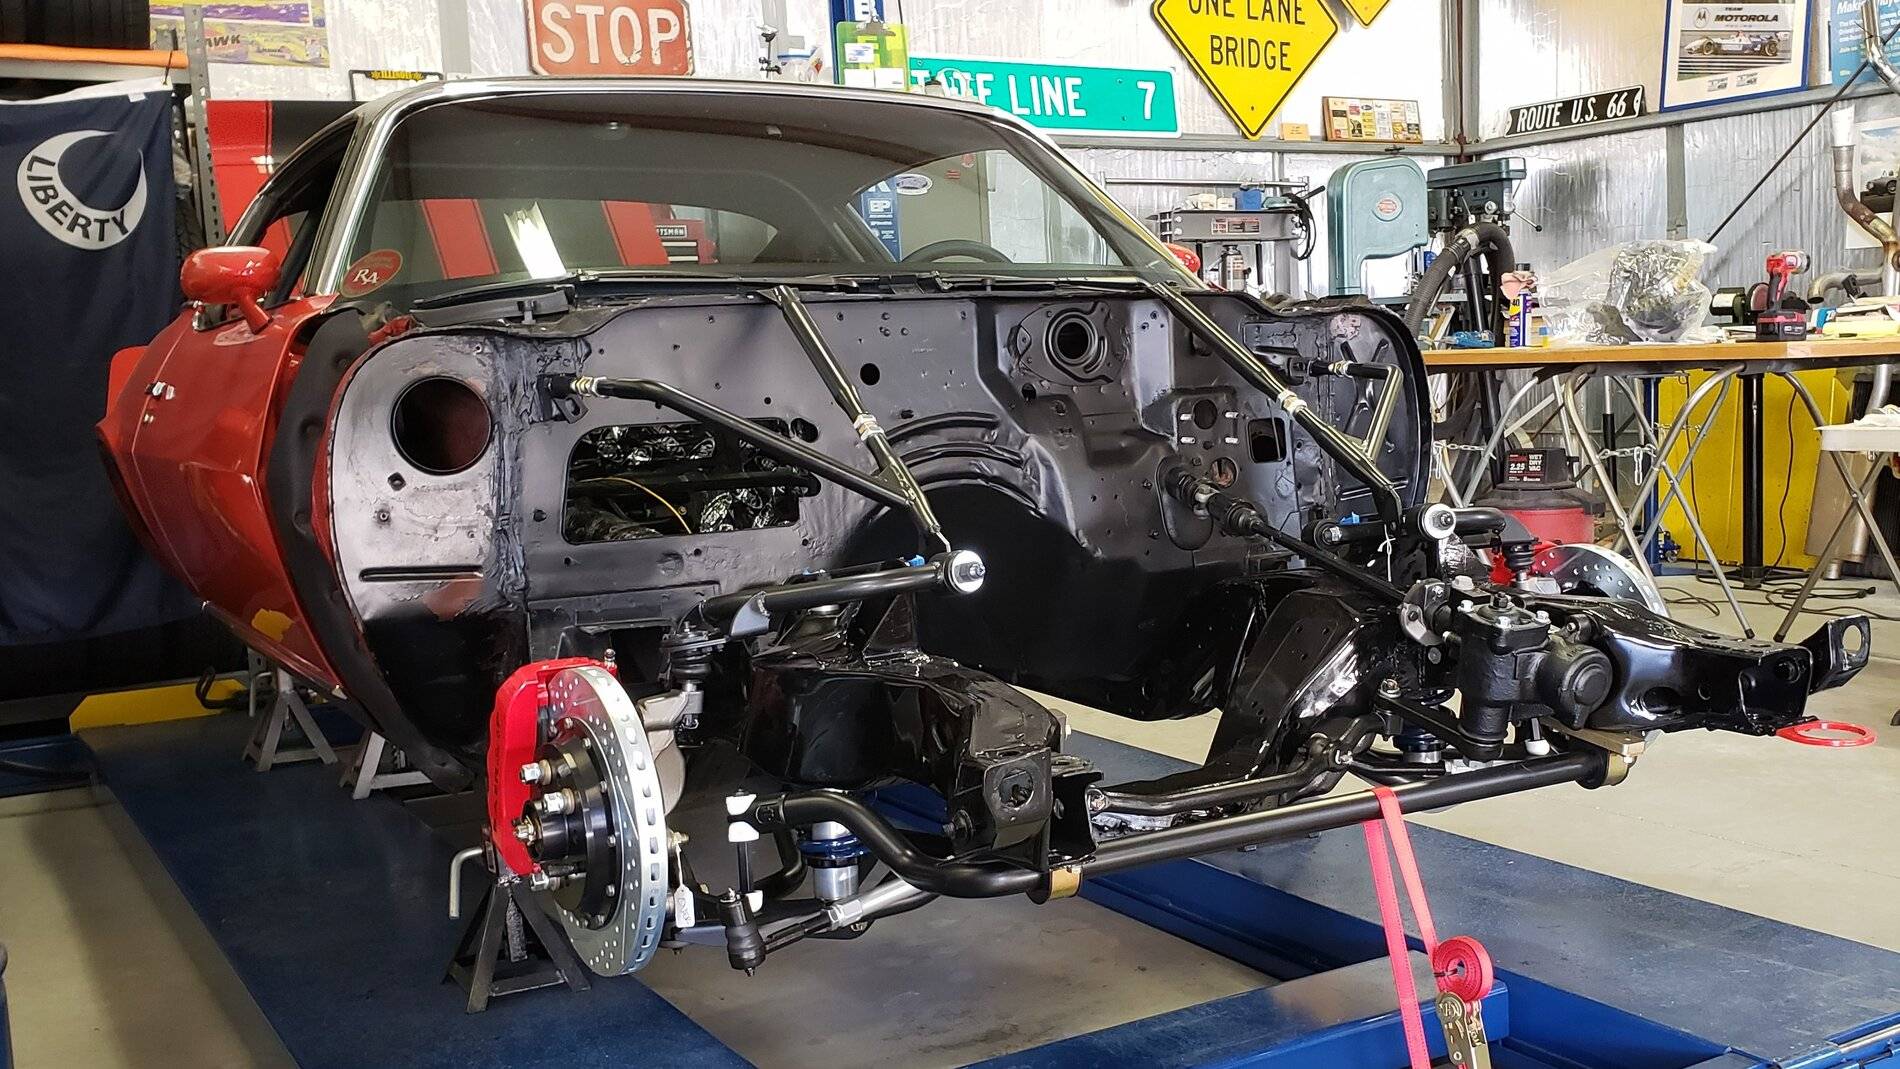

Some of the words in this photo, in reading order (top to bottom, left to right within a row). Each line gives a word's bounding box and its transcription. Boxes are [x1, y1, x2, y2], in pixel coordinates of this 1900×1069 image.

[1246, 0, 1306, 25] LANE
[1714, 14, 1779, 22] MOTOROLA
[204, 34, 241, 48] AWK
[541, 2, 680, 66] STOP
[1210, 35, 1292, 72] BRIDGE
[1008, 74, 1087, 117] LINE
[1137, 80, 1157, 120] 7
[1516, 102, 1563, 133] ROUTE
[1571, 96, 1598, 124] U.S.
[1606, 91, 1629, 119] 66
[27, 154, 129, 242] LIBERTY
[656, 228, 684, 236] TSMAN
